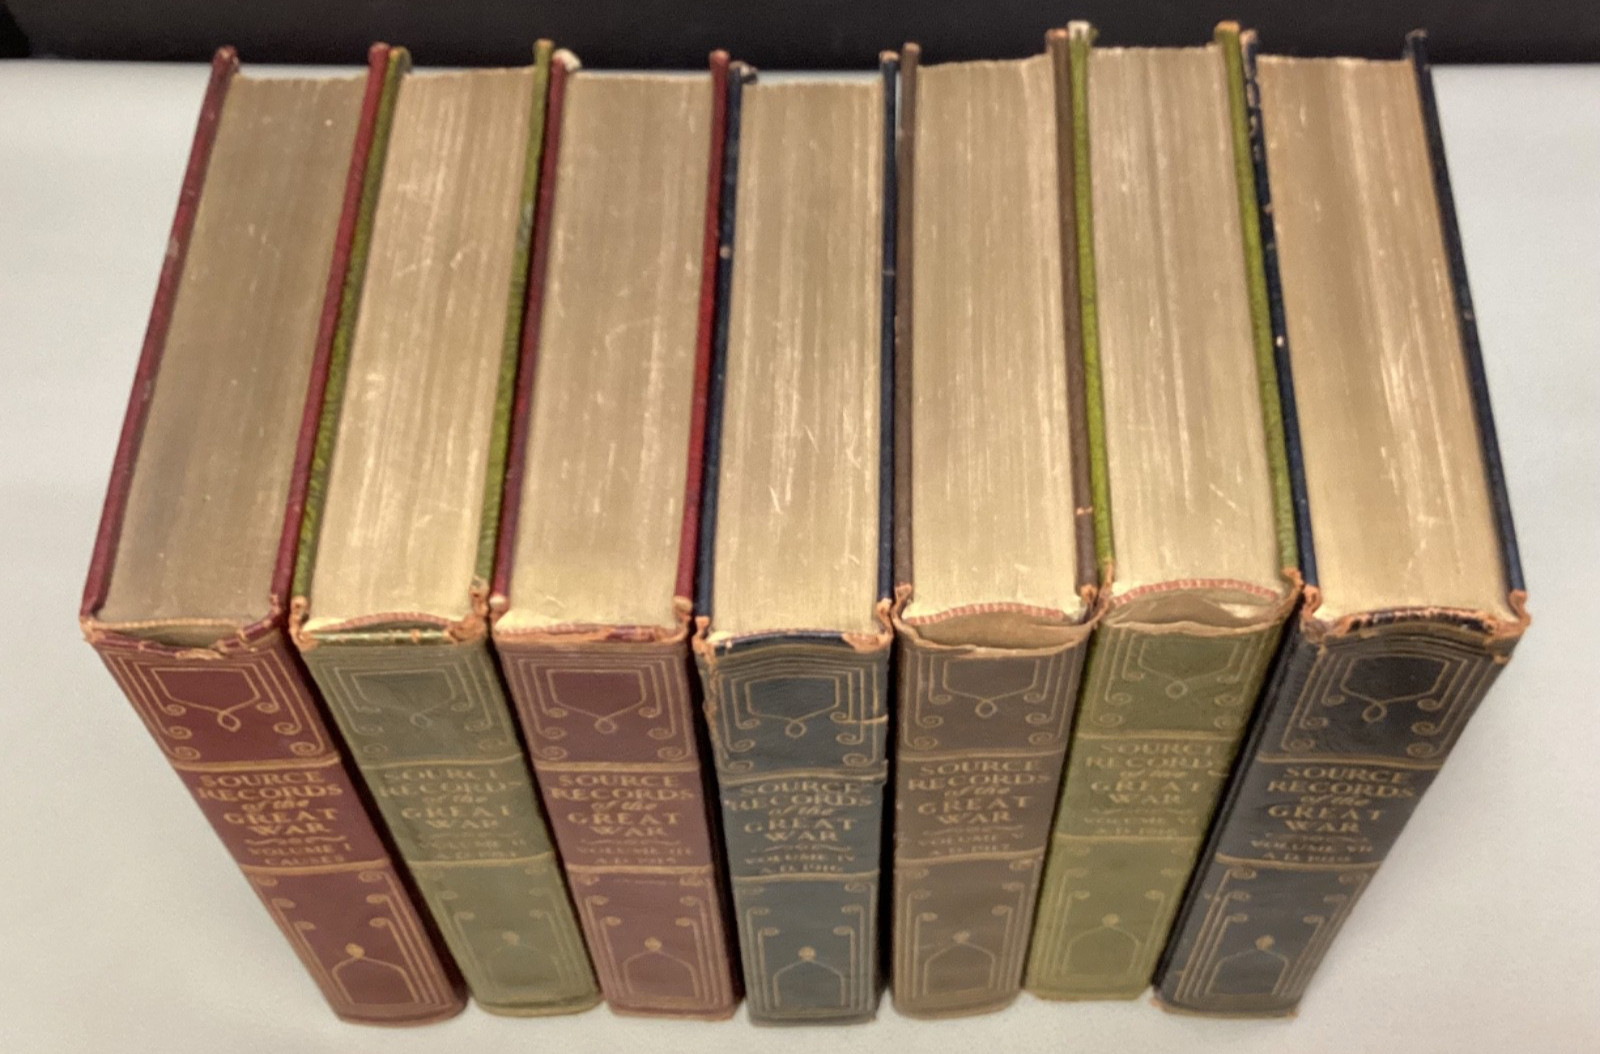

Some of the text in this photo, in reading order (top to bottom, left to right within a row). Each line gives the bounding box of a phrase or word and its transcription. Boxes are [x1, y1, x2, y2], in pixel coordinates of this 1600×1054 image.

[921, 761, 1039, 775] SOURCE
[199, 771, 324, 787] SOURCE
[559, 775, 679, 787] SOURCE
[908, 773, 1050, 790] RECORDS
[1285, 767, 1409, 783] SOURCE
[197, 784, 343, 801] RECORDS
[740, 781, 863, 795] SOURCE
[944, 786, 1010, 797] of the
[1091, 780, 1203, 792] GREAT
[1267, 781, 1414, 797] RECORDS
[550, 787, 695, 800] RECORDS
[1109, 793, 1181, 804] WAR
[1300, 794, 1370, 806] of the
[242, 799, 310, 812] of the
[591, 800, 658, 812] of the
[723, 793, 873, 811] RECORDS
[918, 796, 1031, 814] GREAT
[223, 808, 338, 824] GREAT
[401, 806, 513, 819] GREAT
[768, 806, 834, 817] of the
[937, 811, 1012, 824] WAR
[1268, 805, 1384, 821] GREAT
[568, 812, 682, 825] GREAT
[744, 817, 857, 833] GREAT
[248, 823, 332, 835] WAR
[590, 826, 668, 837] WAR
[1285, 820, 1360, 832] WAR
[764, 830, 838, 842] WAR
[248, 845, 332, 856] VOLUME
